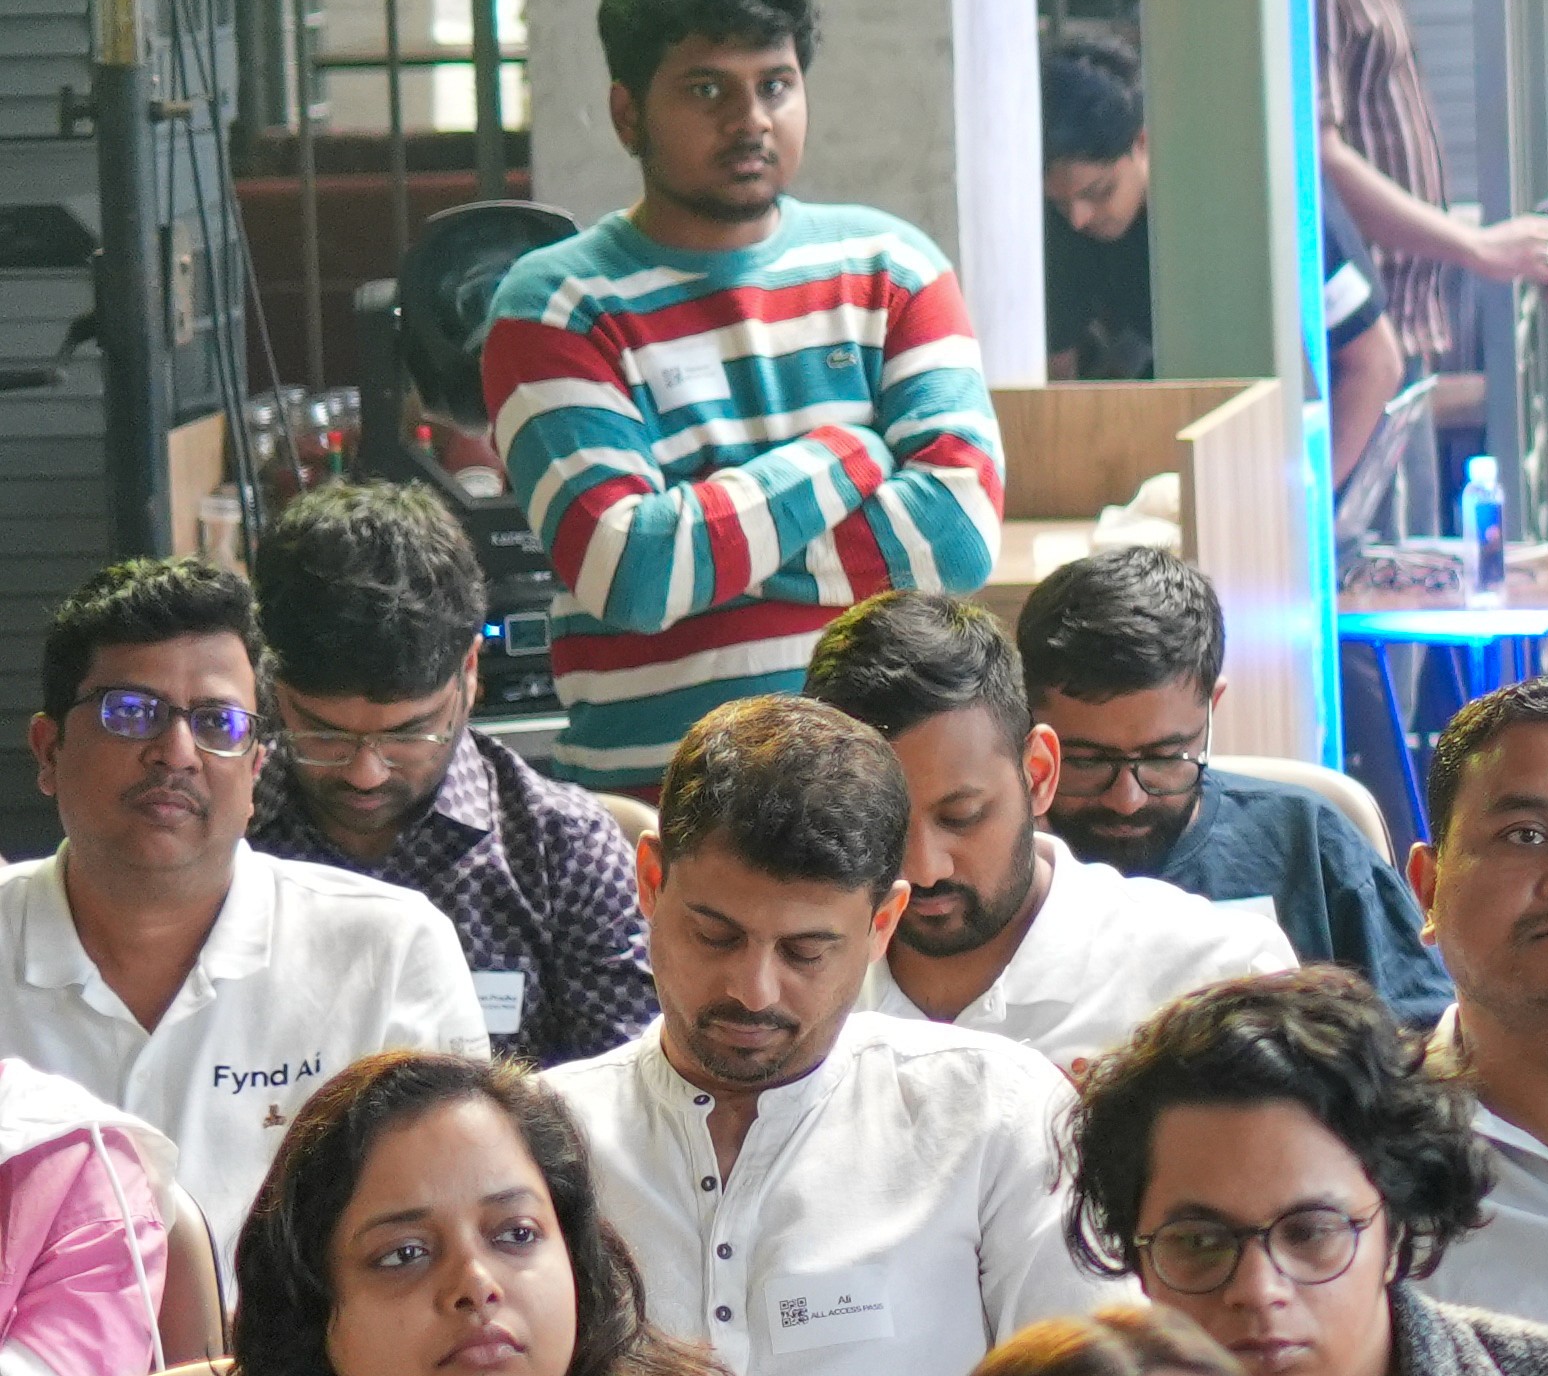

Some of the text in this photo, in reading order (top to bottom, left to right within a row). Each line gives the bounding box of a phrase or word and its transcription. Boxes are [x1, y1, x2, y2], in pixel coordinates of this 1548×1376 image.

[214, 1051, 321, 1094] Fynd Ai
[811, 1303, 884, 1320] ALL ACCESS PASS
